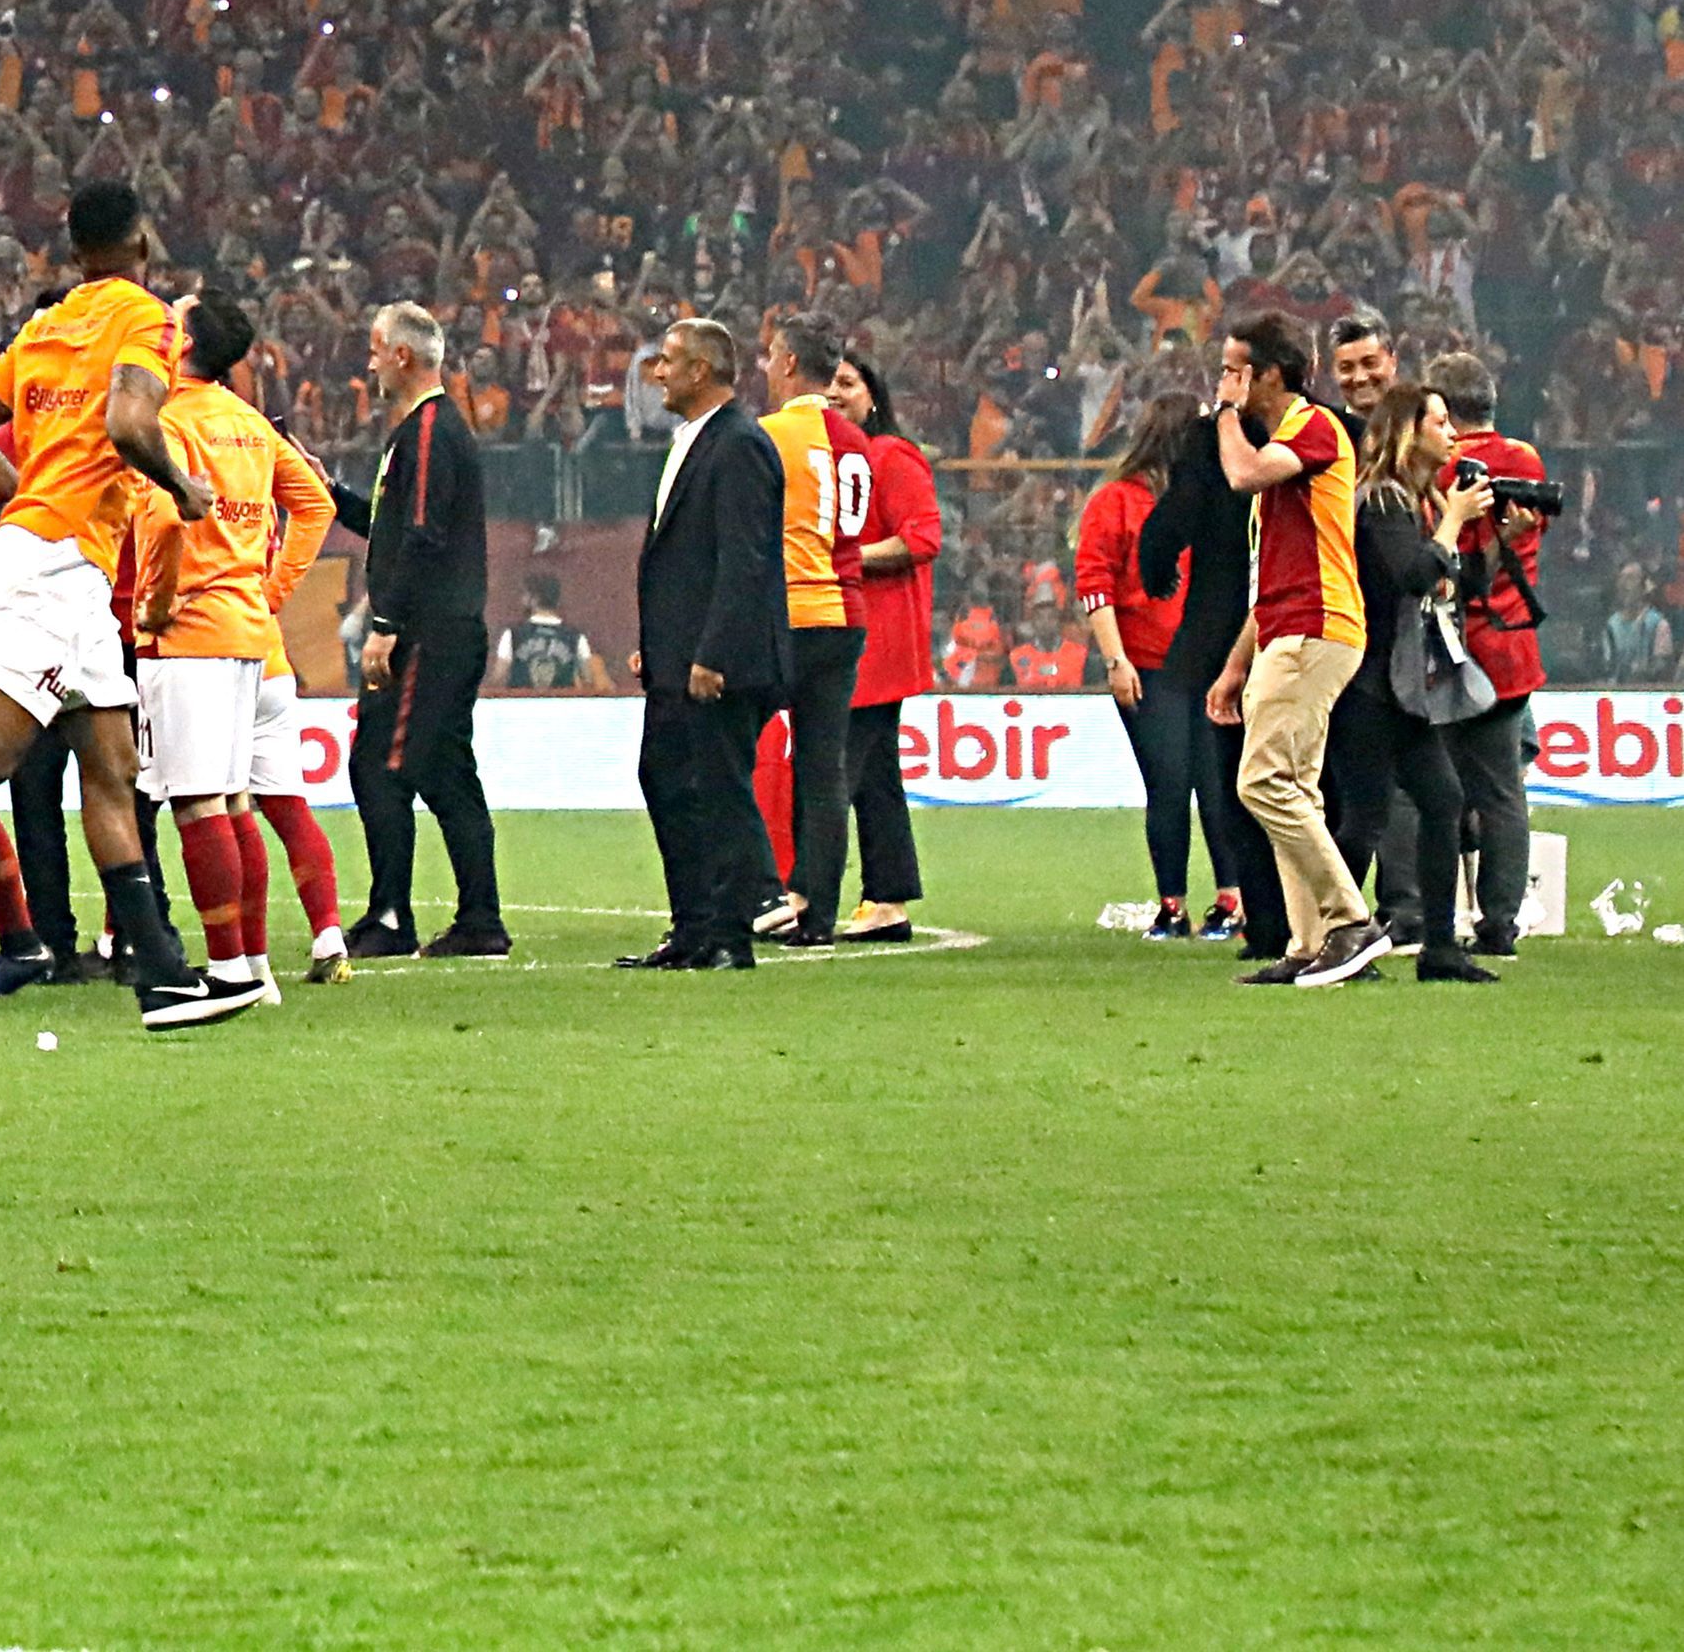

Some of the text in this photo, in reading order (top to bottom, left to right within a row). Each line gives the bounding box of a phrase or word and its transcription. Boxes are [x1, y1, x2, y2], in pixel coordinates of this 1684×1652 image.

[807, 448, 872, 537] 10
[897, 699, 1071, 780] ebir
[1534, 698, 1684, 778] ebi
